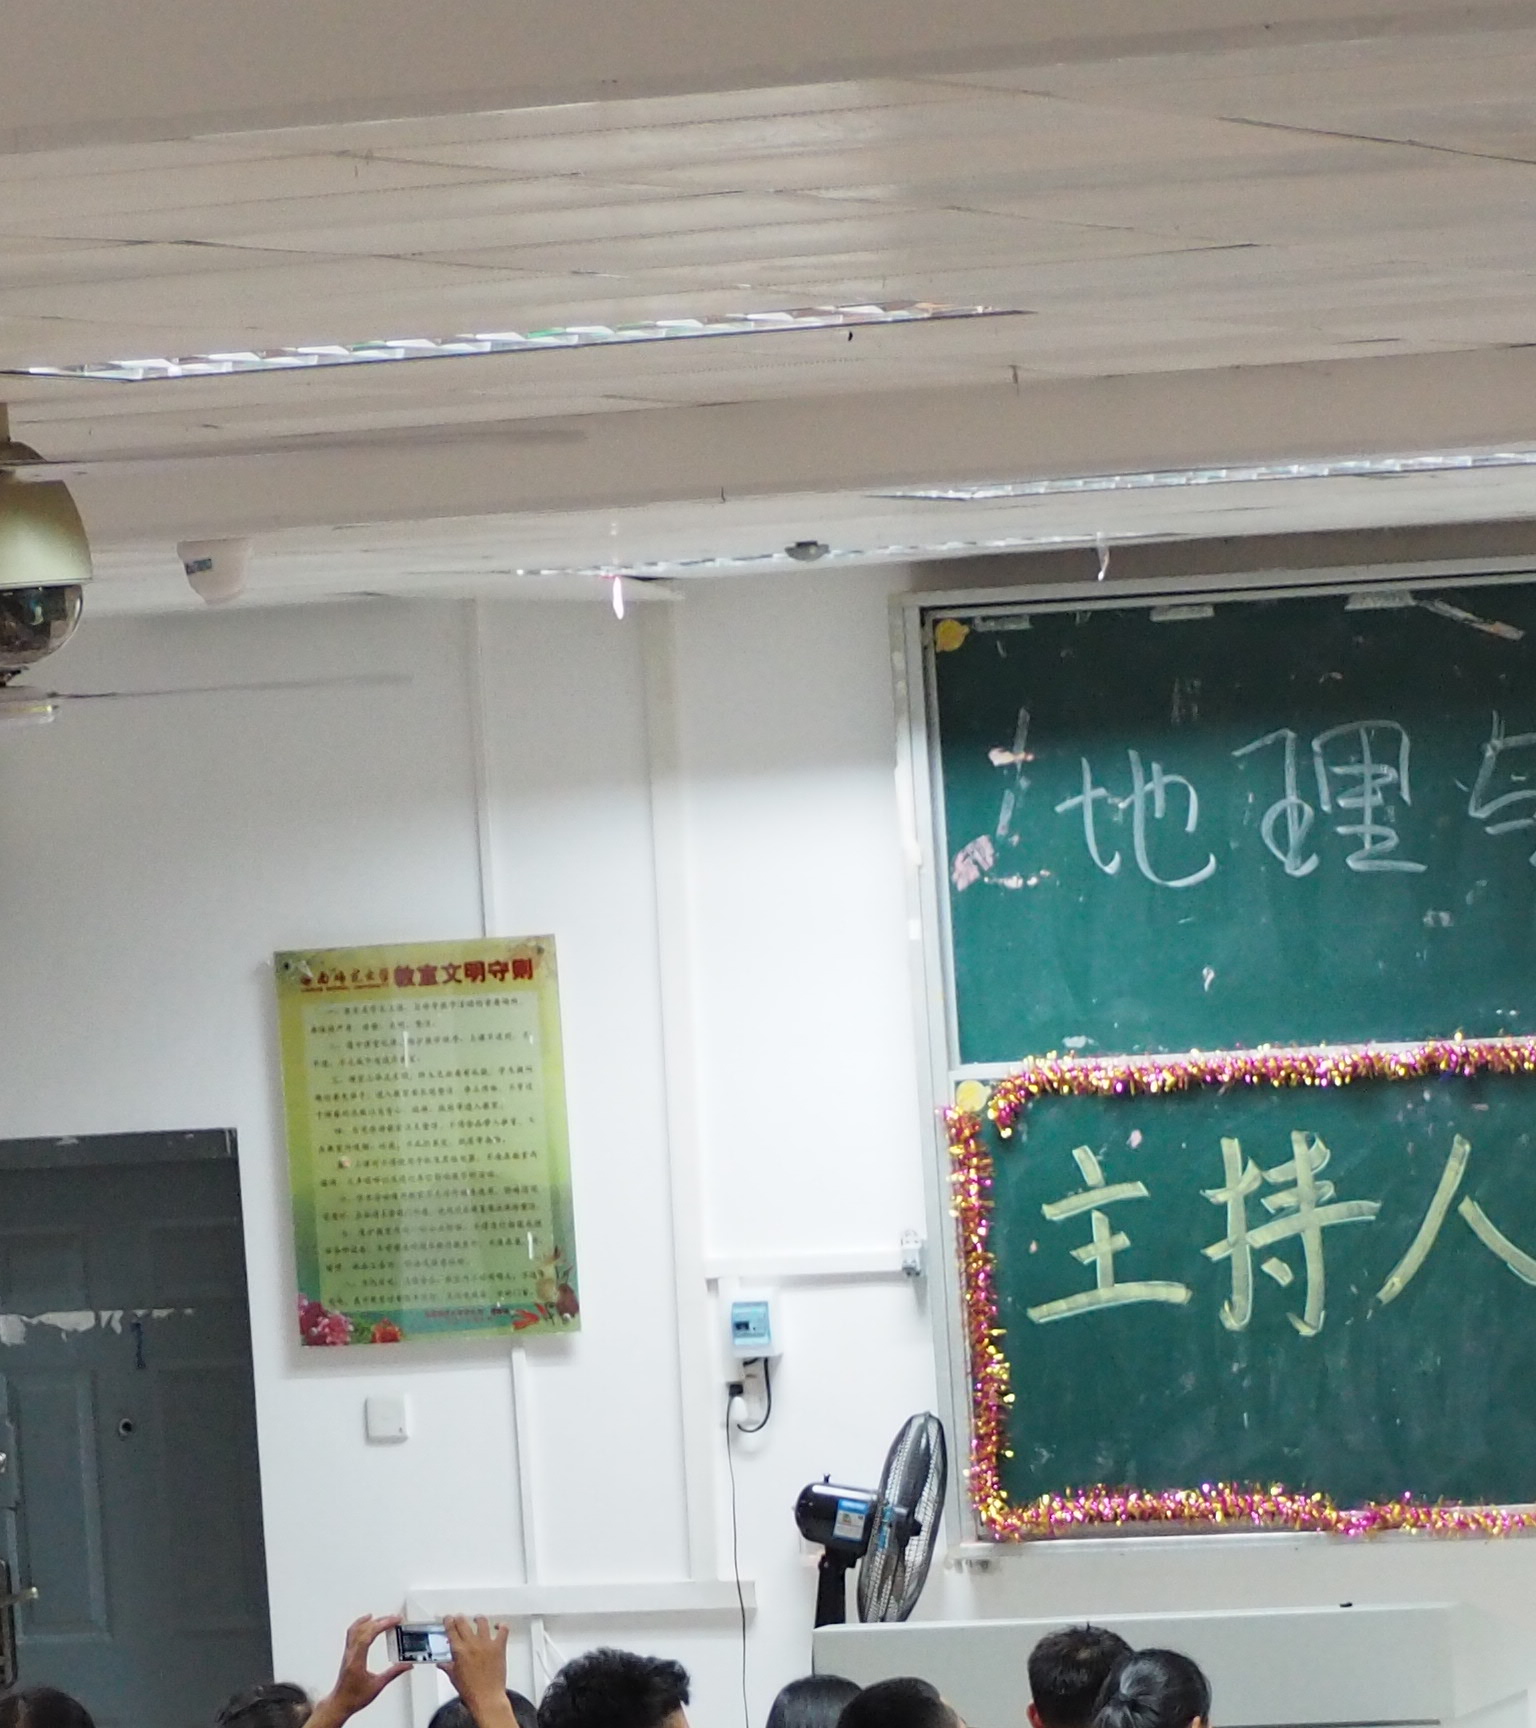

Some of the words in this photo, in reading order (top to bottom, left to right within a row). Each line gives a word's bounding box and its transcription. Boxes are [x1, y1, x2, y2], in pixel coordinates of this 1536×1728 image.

[393, 957, 534, 988] 教室文明守则
